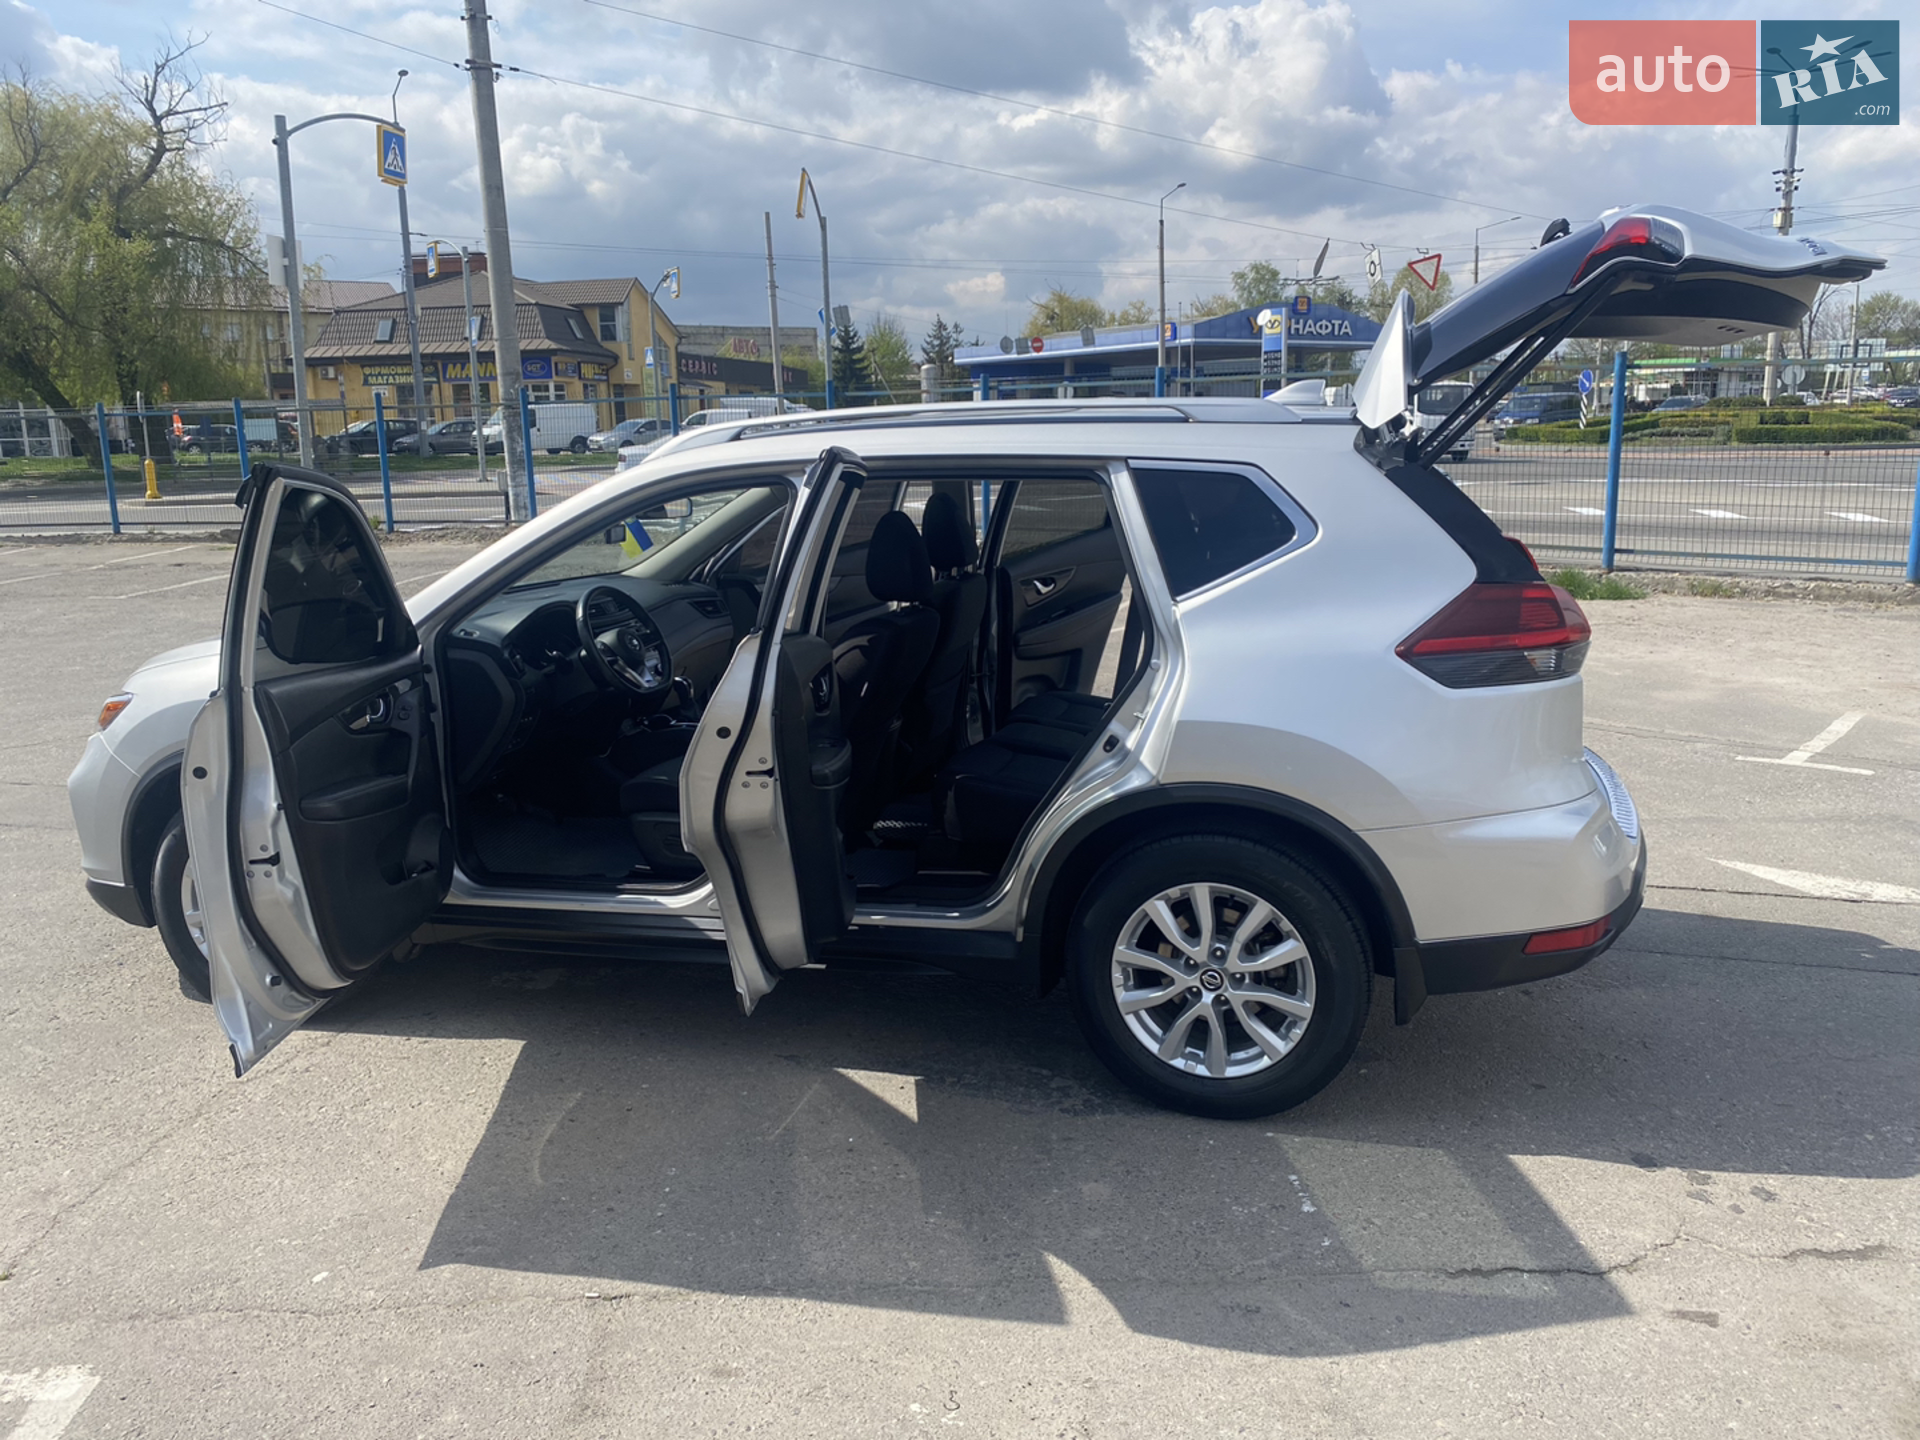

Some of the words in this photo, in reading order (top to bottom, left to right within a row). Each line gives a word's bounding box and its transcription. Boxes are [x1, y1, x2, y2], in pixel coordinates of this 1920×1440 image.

[1248, 316, 1353, 337] УНАФТА
[681, 358, 718, 376] СЕРВІС
[367, 375, 414, 385] МАГАЗИН
